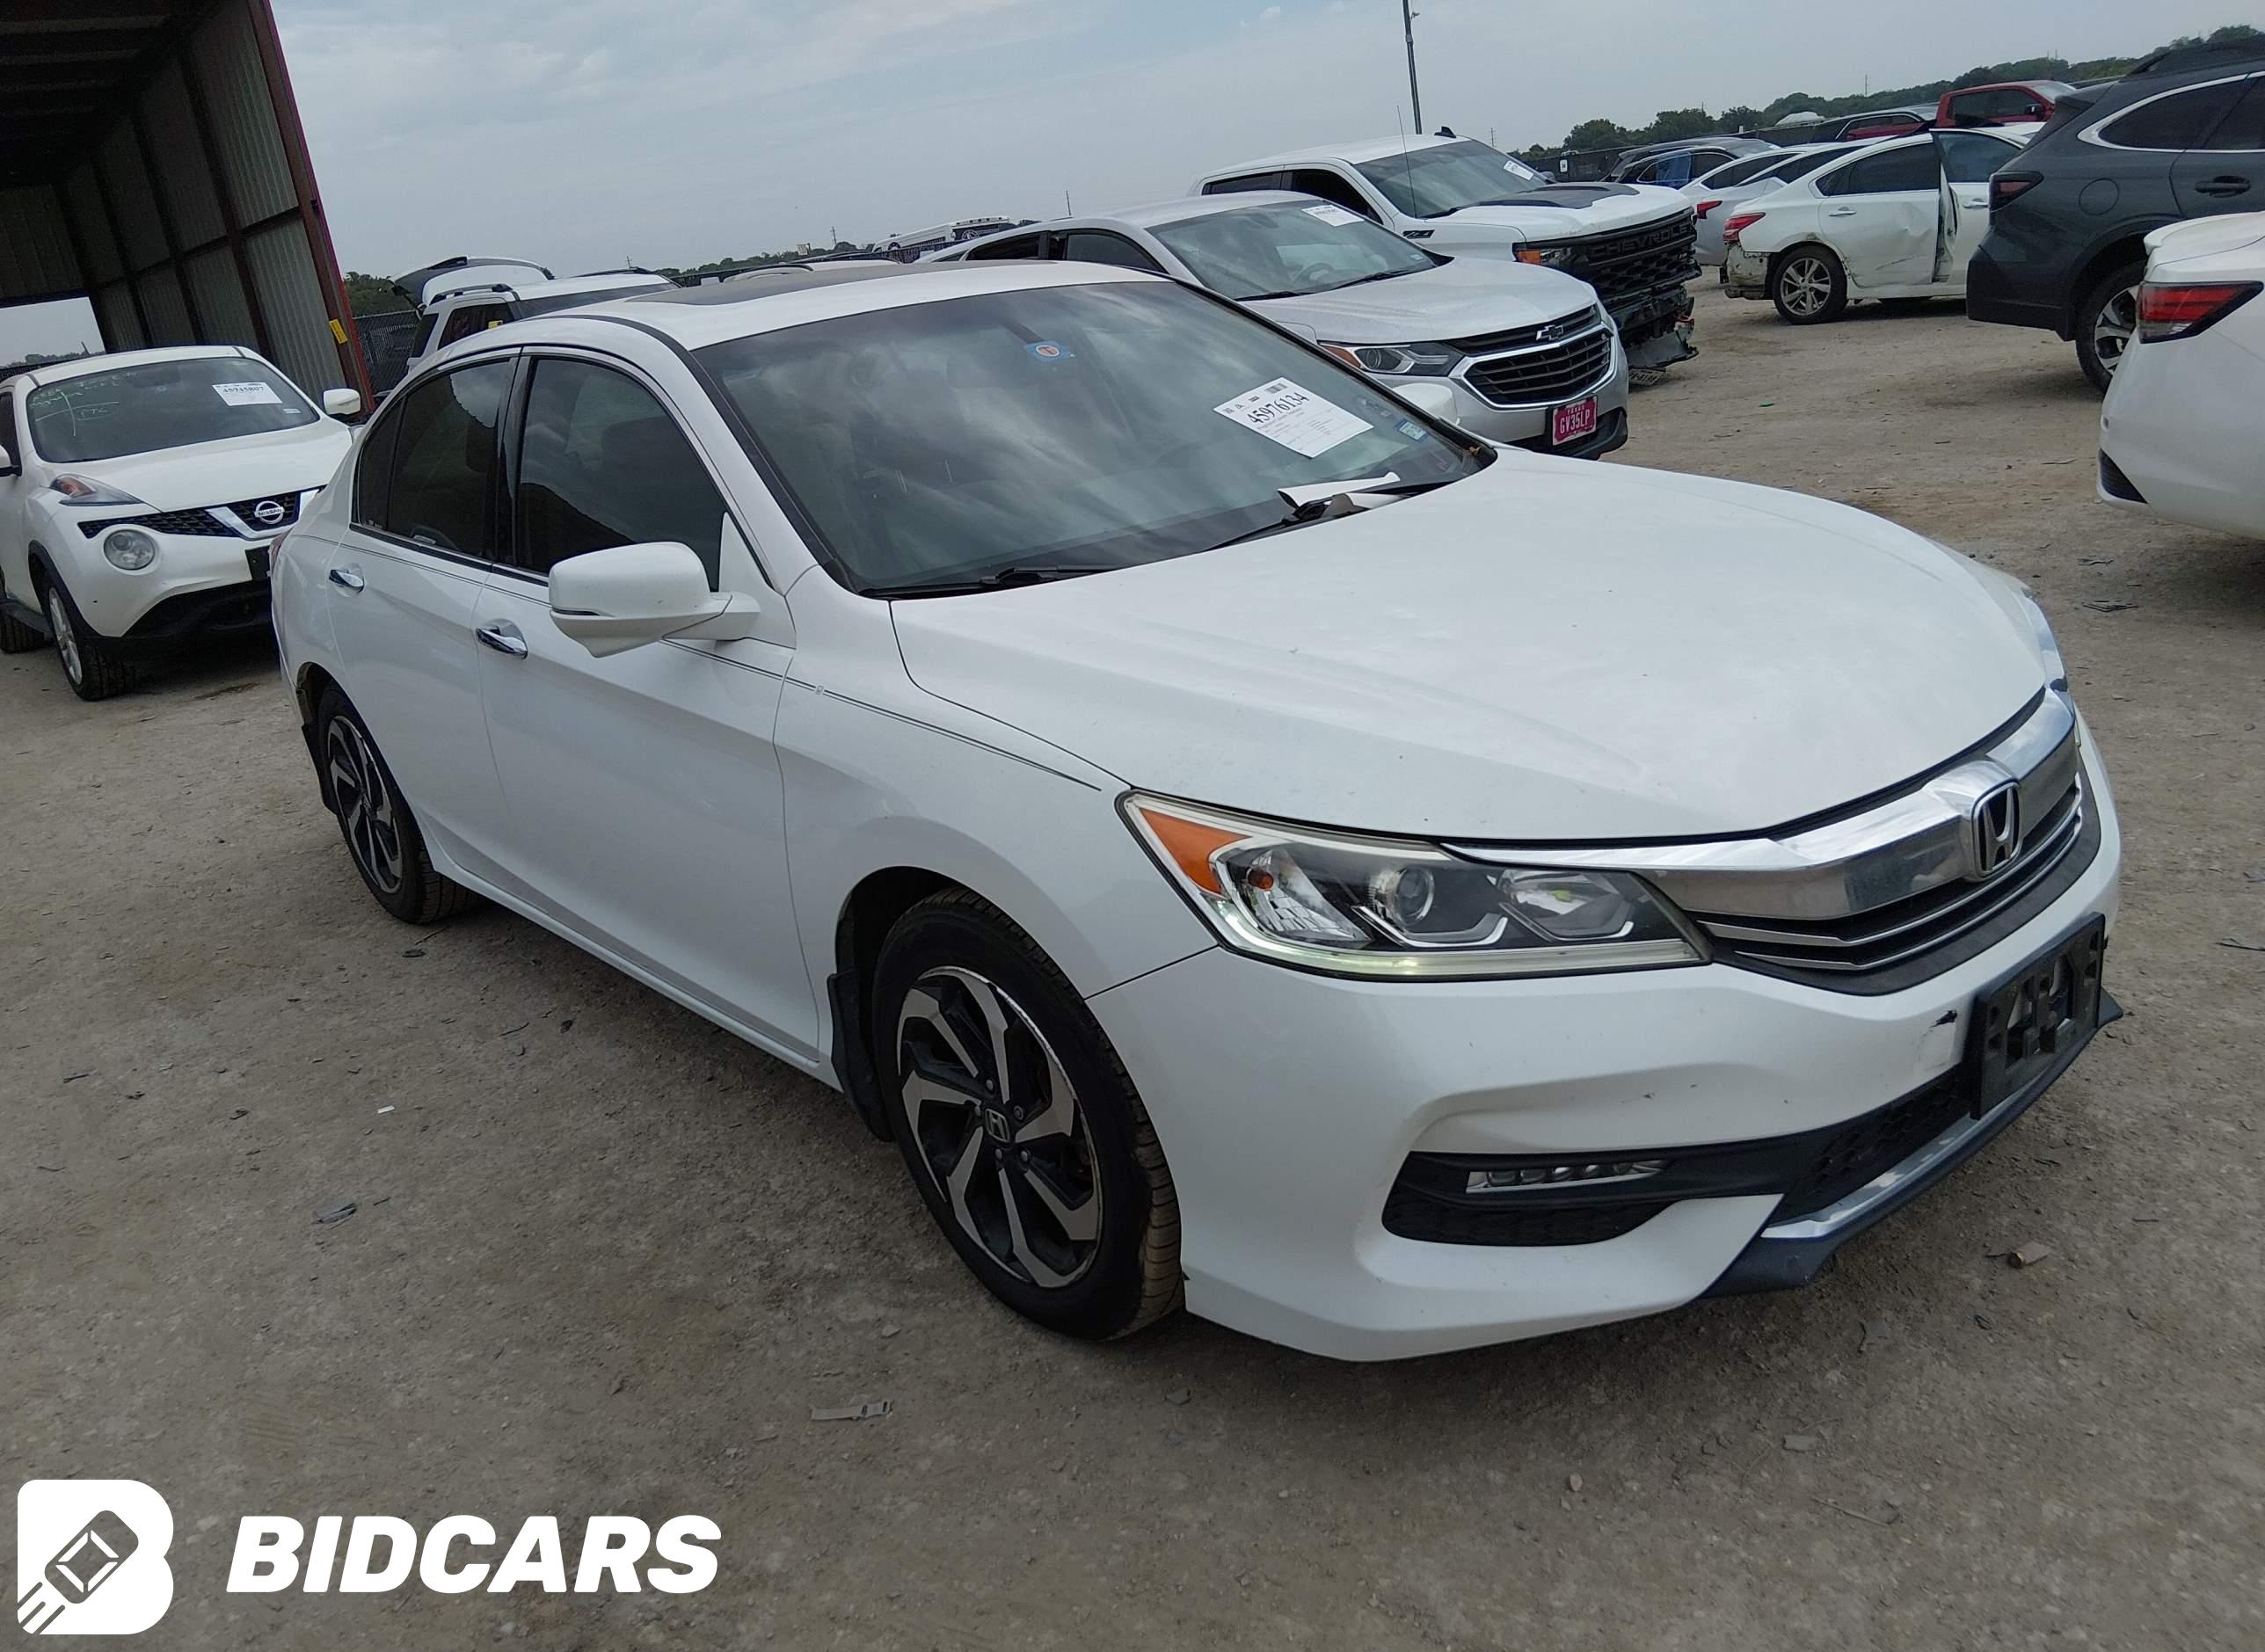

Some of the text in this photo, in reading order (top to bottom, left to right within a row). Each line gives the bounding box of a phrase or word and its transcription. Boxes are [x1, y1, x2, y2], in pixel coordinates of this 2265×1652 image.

[1589, 222, 1693, 258] CHEVROLE
[1246, 391, 1311, 424] 45976134
[1560, 409, 1591, 434] GV35LP
